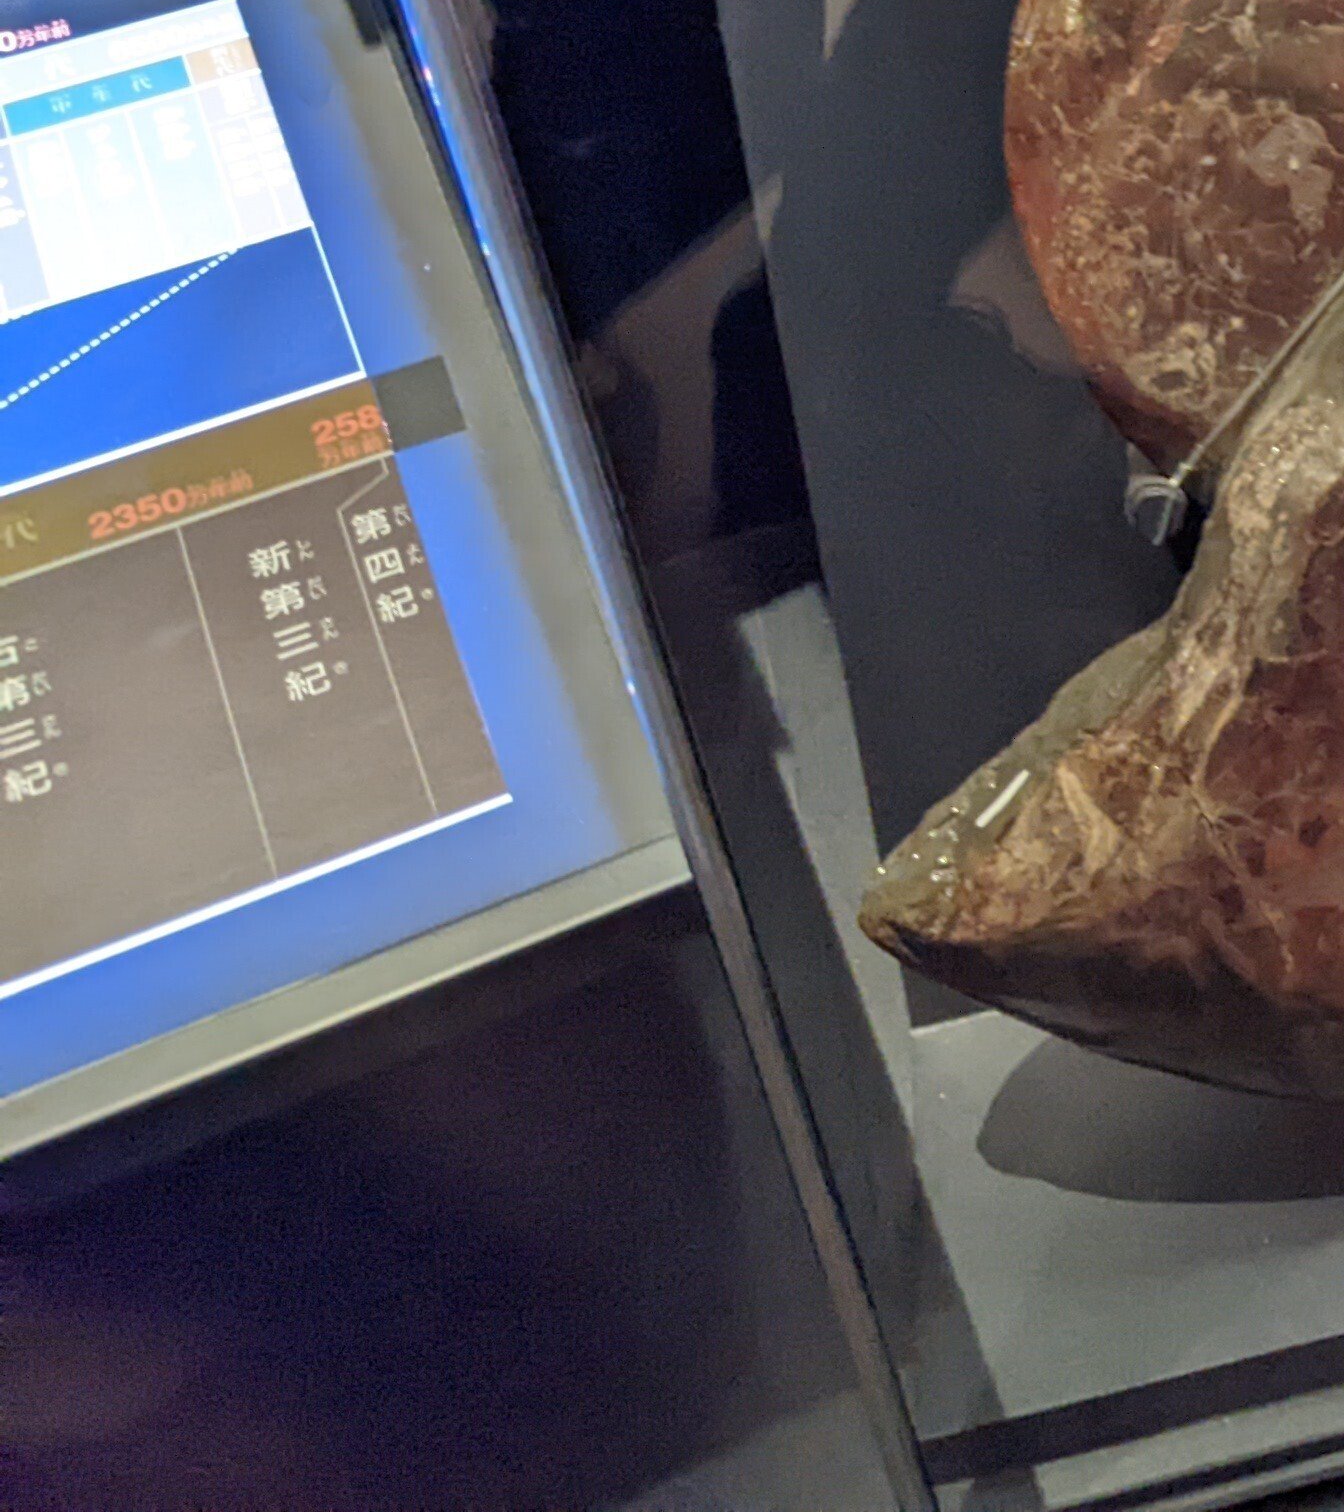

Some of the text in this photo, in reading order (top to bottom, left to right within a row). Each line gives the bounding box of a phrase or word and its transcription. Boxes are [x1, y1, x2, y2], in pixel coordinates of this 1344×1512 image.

[311, 405, 380, 446] 258
[249, 540, 332, 701] 新第三紀
[351, 507, 419, 623] 第四紀
